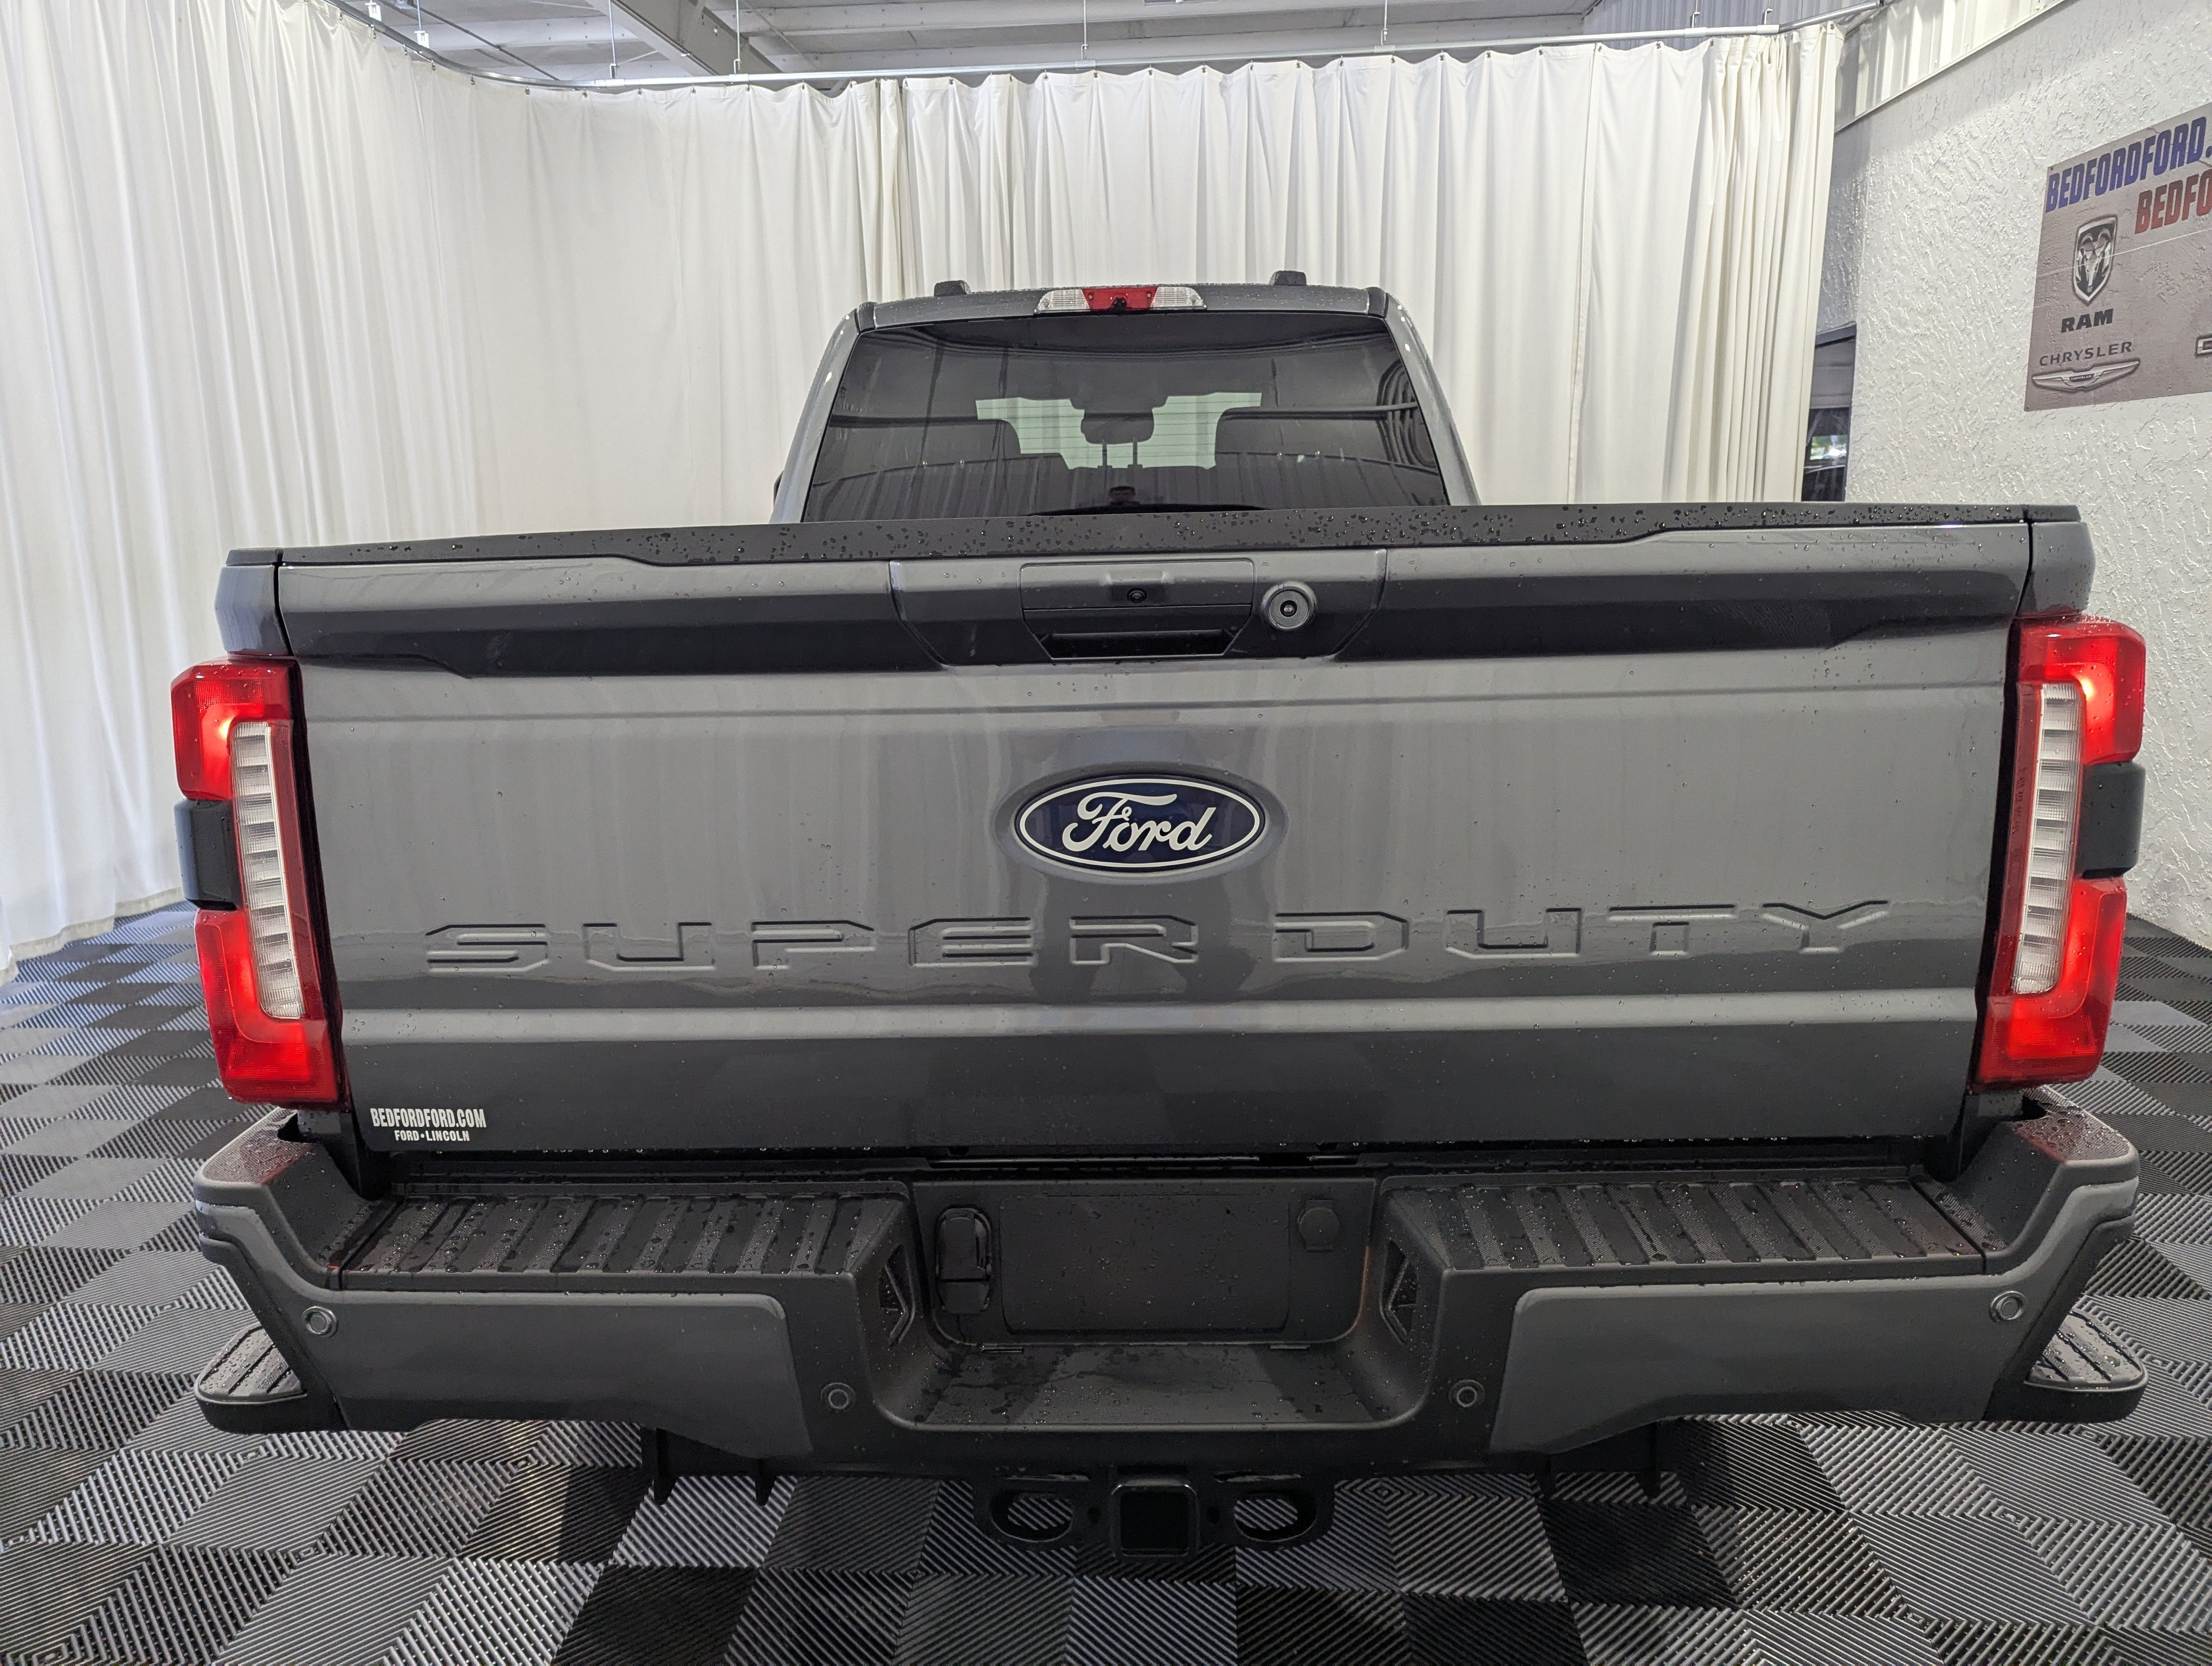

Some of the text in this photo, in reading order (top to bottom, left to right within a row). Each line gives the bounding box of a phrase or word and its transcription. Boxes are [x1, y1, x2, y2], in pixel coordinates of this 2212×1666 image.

[2134, 169, 2212, 234] BEDFO
[2061, 309, 2114, 334] RAM
[2039, 341, 2132, 366] CHRYSLER
[1062, 791, 1217, 852] Ford
[425, 899, 1891, 973] SUPER DUTY
[370, 1108, 487, 1128] BEDFORDFORD.COM
